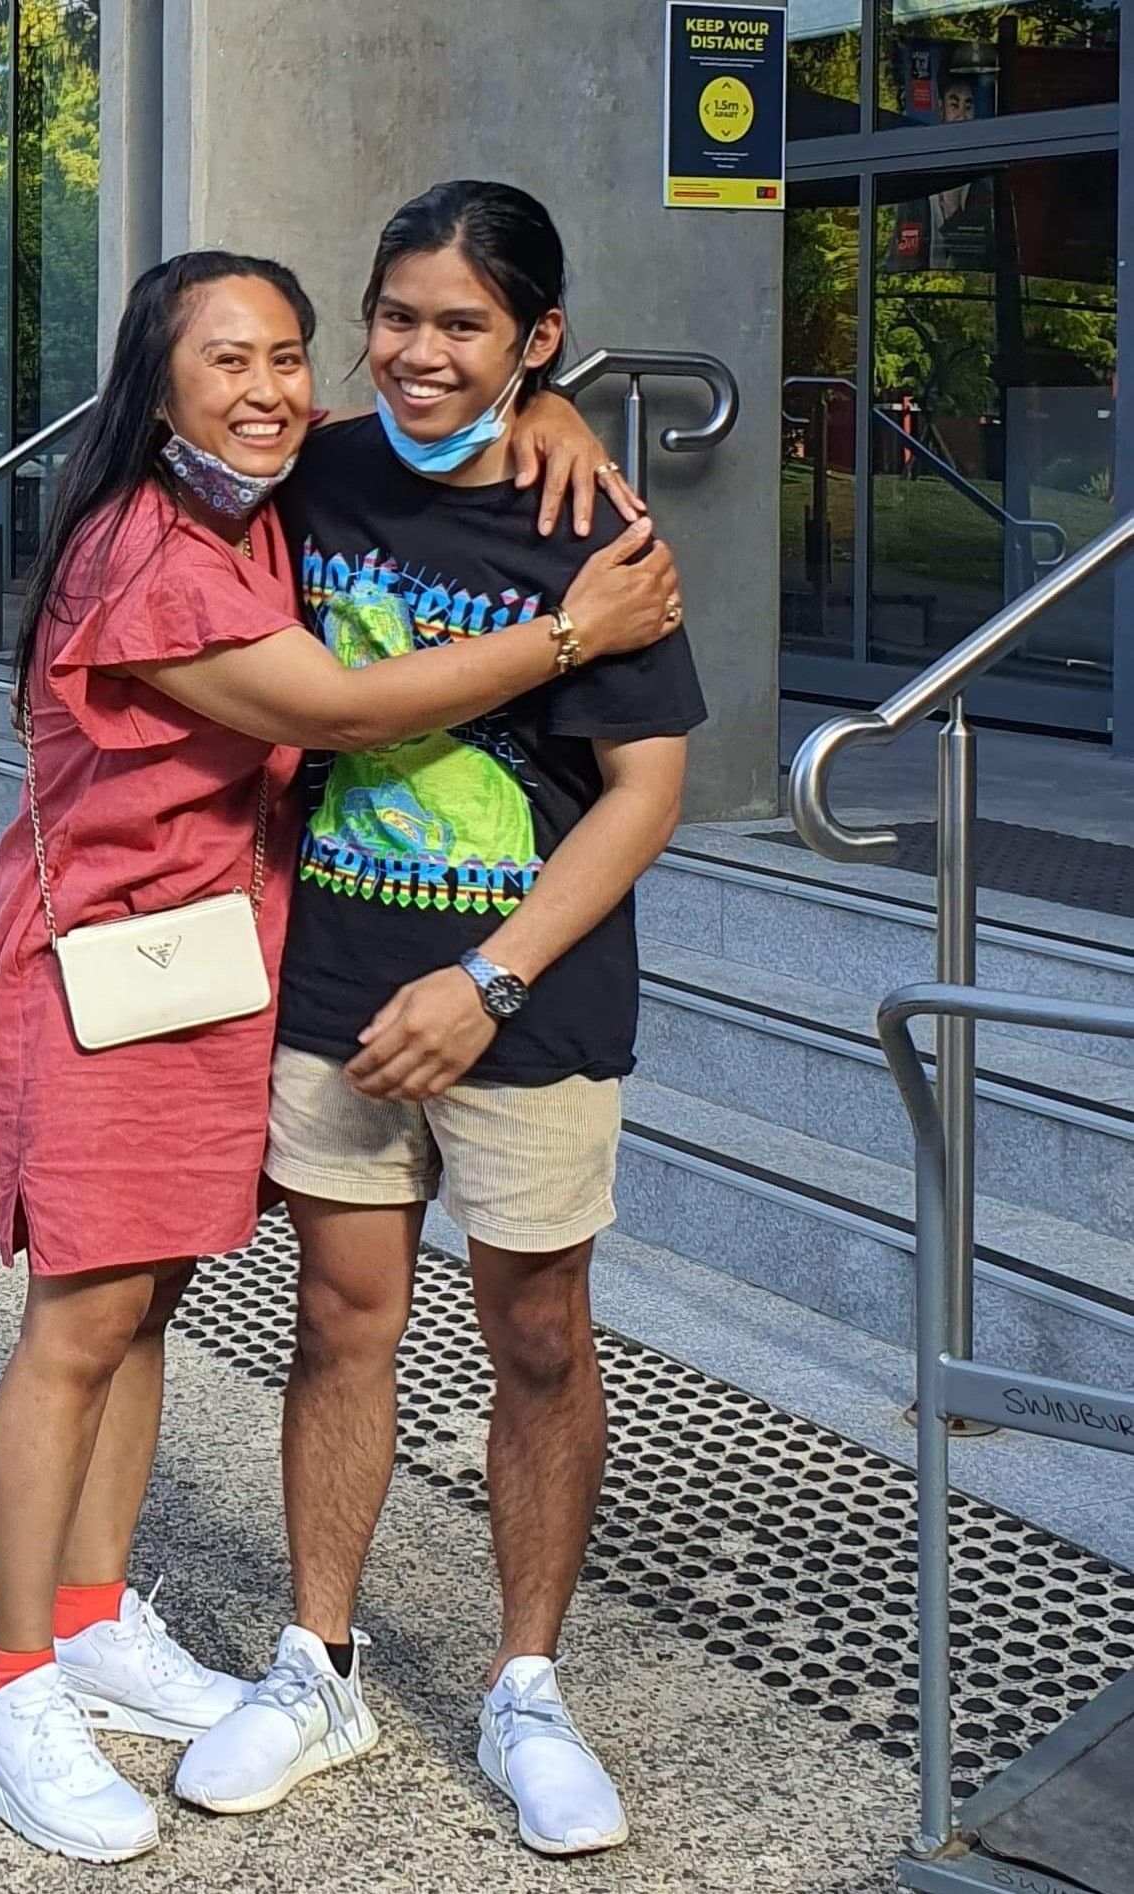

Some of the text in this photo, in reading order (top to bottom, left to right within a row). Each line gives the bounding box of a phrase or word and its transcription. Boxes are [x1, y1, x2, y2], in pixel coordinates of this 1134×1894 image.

[686, 18, 769, 35] KEEP YOUR
[691, 35, 764, 51] DISTANCE
[714, 100, 738, 110] 1.5m
[1002, 1388, 1134, 1436] SWINBUR
